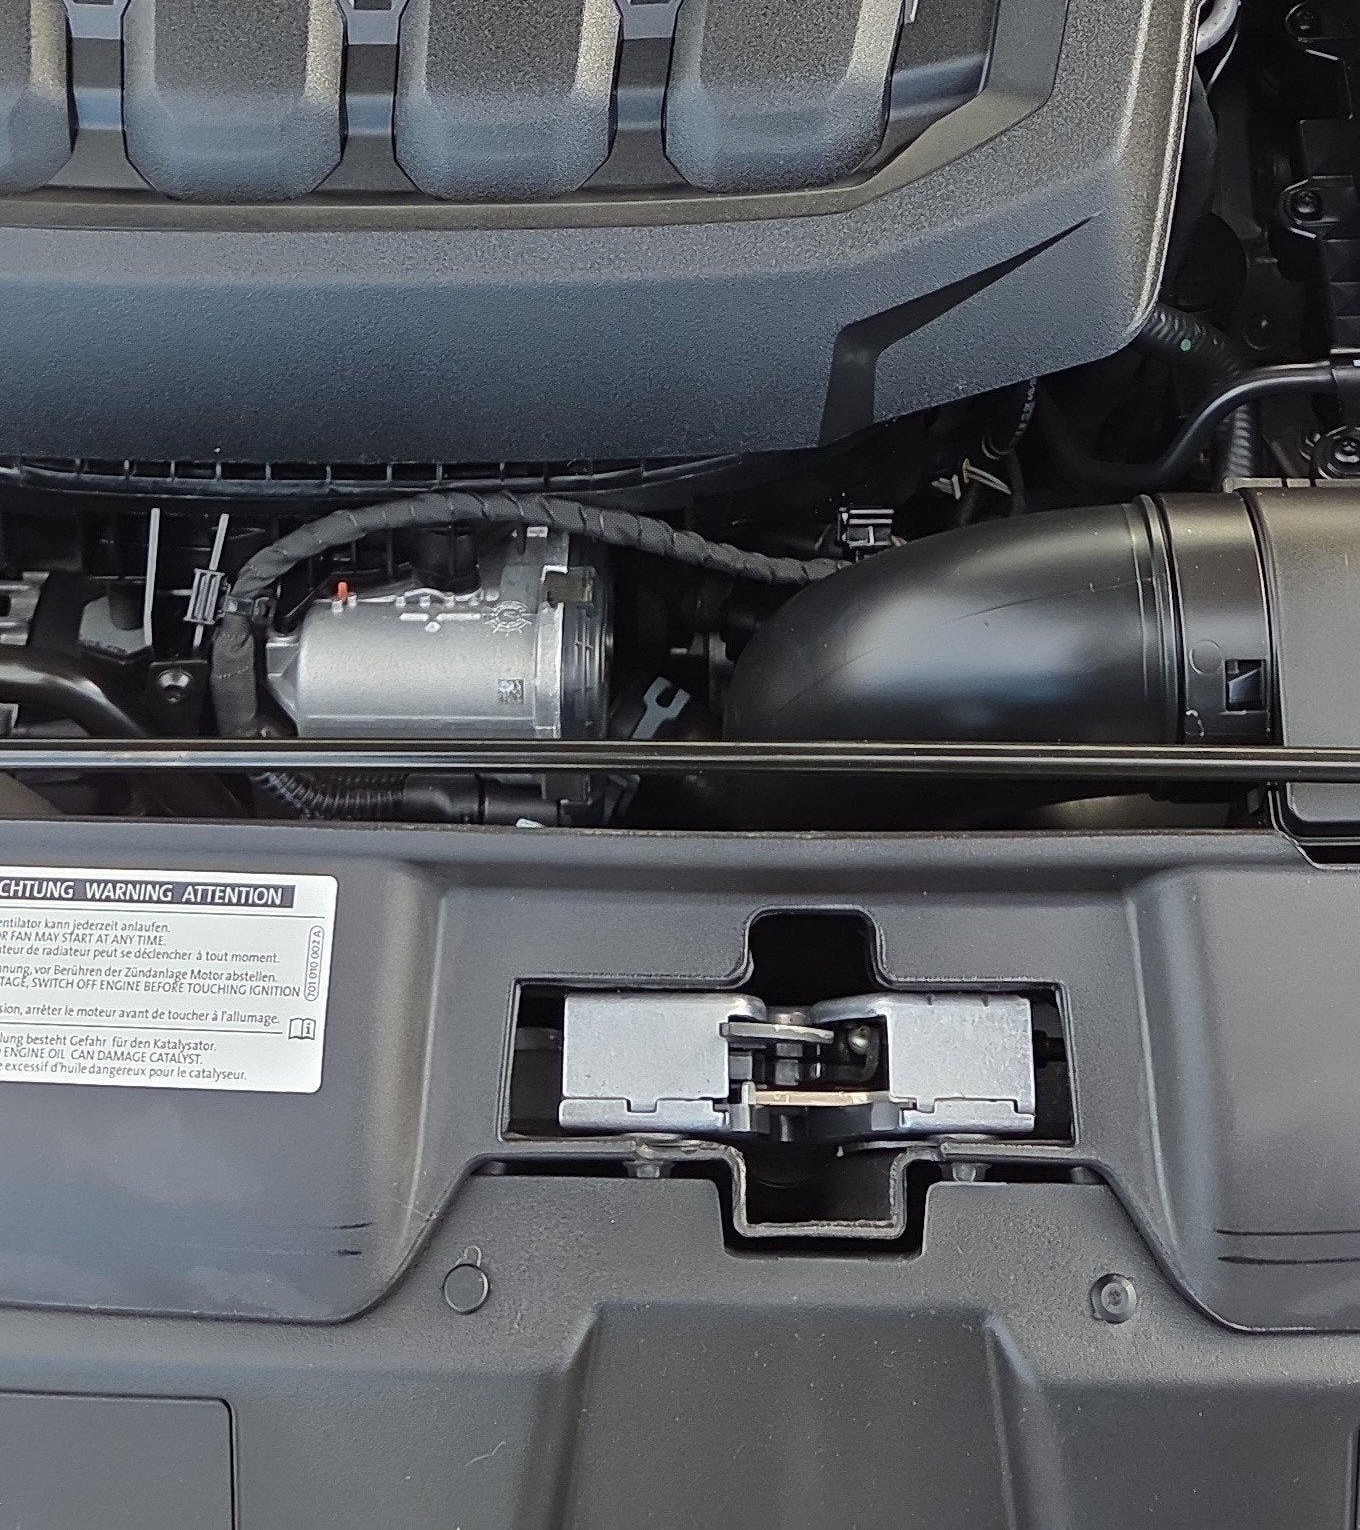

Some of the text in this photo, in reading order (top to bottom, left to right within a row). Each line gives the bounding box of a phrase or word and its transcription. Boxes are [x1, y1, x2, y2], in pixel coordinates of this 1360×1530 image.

[86, 882, 173, 901] WARNING
[182, 886, 282, 905] ATTENTION
[44, 919, 70, 930] kann
[71, 919, 118, 933] jederzeit
[121, 921, 171, 933] anlaufen.
[313, 930, 321, 938] A
[10, 931, 32, 942] FAN
[34, 931, 59, 943] MAY
[62, 932, 94, 944] START
[96, 934, 110, 944] AT
[111, 934, 135, 945] ANY
[26, 945, 40, 956] de
[42, 945, 91, 957] radiateur
[93, 948, 118, 961] peut
[121, 950, 132, 959] se
[134, 948, 192, 960] déclencher
[196, 950, 203, 961] à
[206, 951, 228, 962] tout
[231, 953, 280, 963] moment.
[311, 940, 320, 959] 002
[34, 966, 51, 975] vor
[54, 965, 102, 977] Berühren
[104, 966, 122, 978] der
[124, 967, 188, 982] Zündanlage
[190, 969, 224, 981] Motor
[225, 970, 278, 983] abstellen.
[309, 963, 318, 979] 010
[31, 977, 74, 989] SWITCH
[76, 979, 98, 990] OFF
[100, 980, 141, 992] ENGINE
[144, 981, 185, 993] BEFORE
[187, 983, 247, 995] TOUCHING
[250, 985, 301, 997] IGNITION
[25, 1005, 62, 1016] arrêter
[64, 1005, 74, 1016] le
[77, 1007, 117, 1018] moteur
[119, 1009, 149, 1019] avant
[152, 1009, 165, 1020] de
[168, 1009, 210, 1021] toucher
[212, 1013, 218, 1022] à
[26, 1033, 67, 1046] besteht
[70, 1035, 107, 1047] Gefahr
[112, 1036, 128, 1048] für
[130, 1037, 151, 1049] den
[153, 1039, 217, 1053] Katalysator.
[4, 1047, 45, 1059] ENGINE
[48, 1048, 65, 1060] OIL
[71, 1049, 95, 1060] CAN
[97, 1050, 146, 1063] DAMAGE
[149, 1052, 203, 1065] CATALYST.
[5, 1061, 49, 1072] excessif
[50, 1062, 87, 1074] d'huile
[88, 1064, 146, 1079] dangereux
[149, 1068, 175, 1079] pour
[177, 1067, 187, 1078] le
[189, 1068, 247, 1082] catalyseur.
